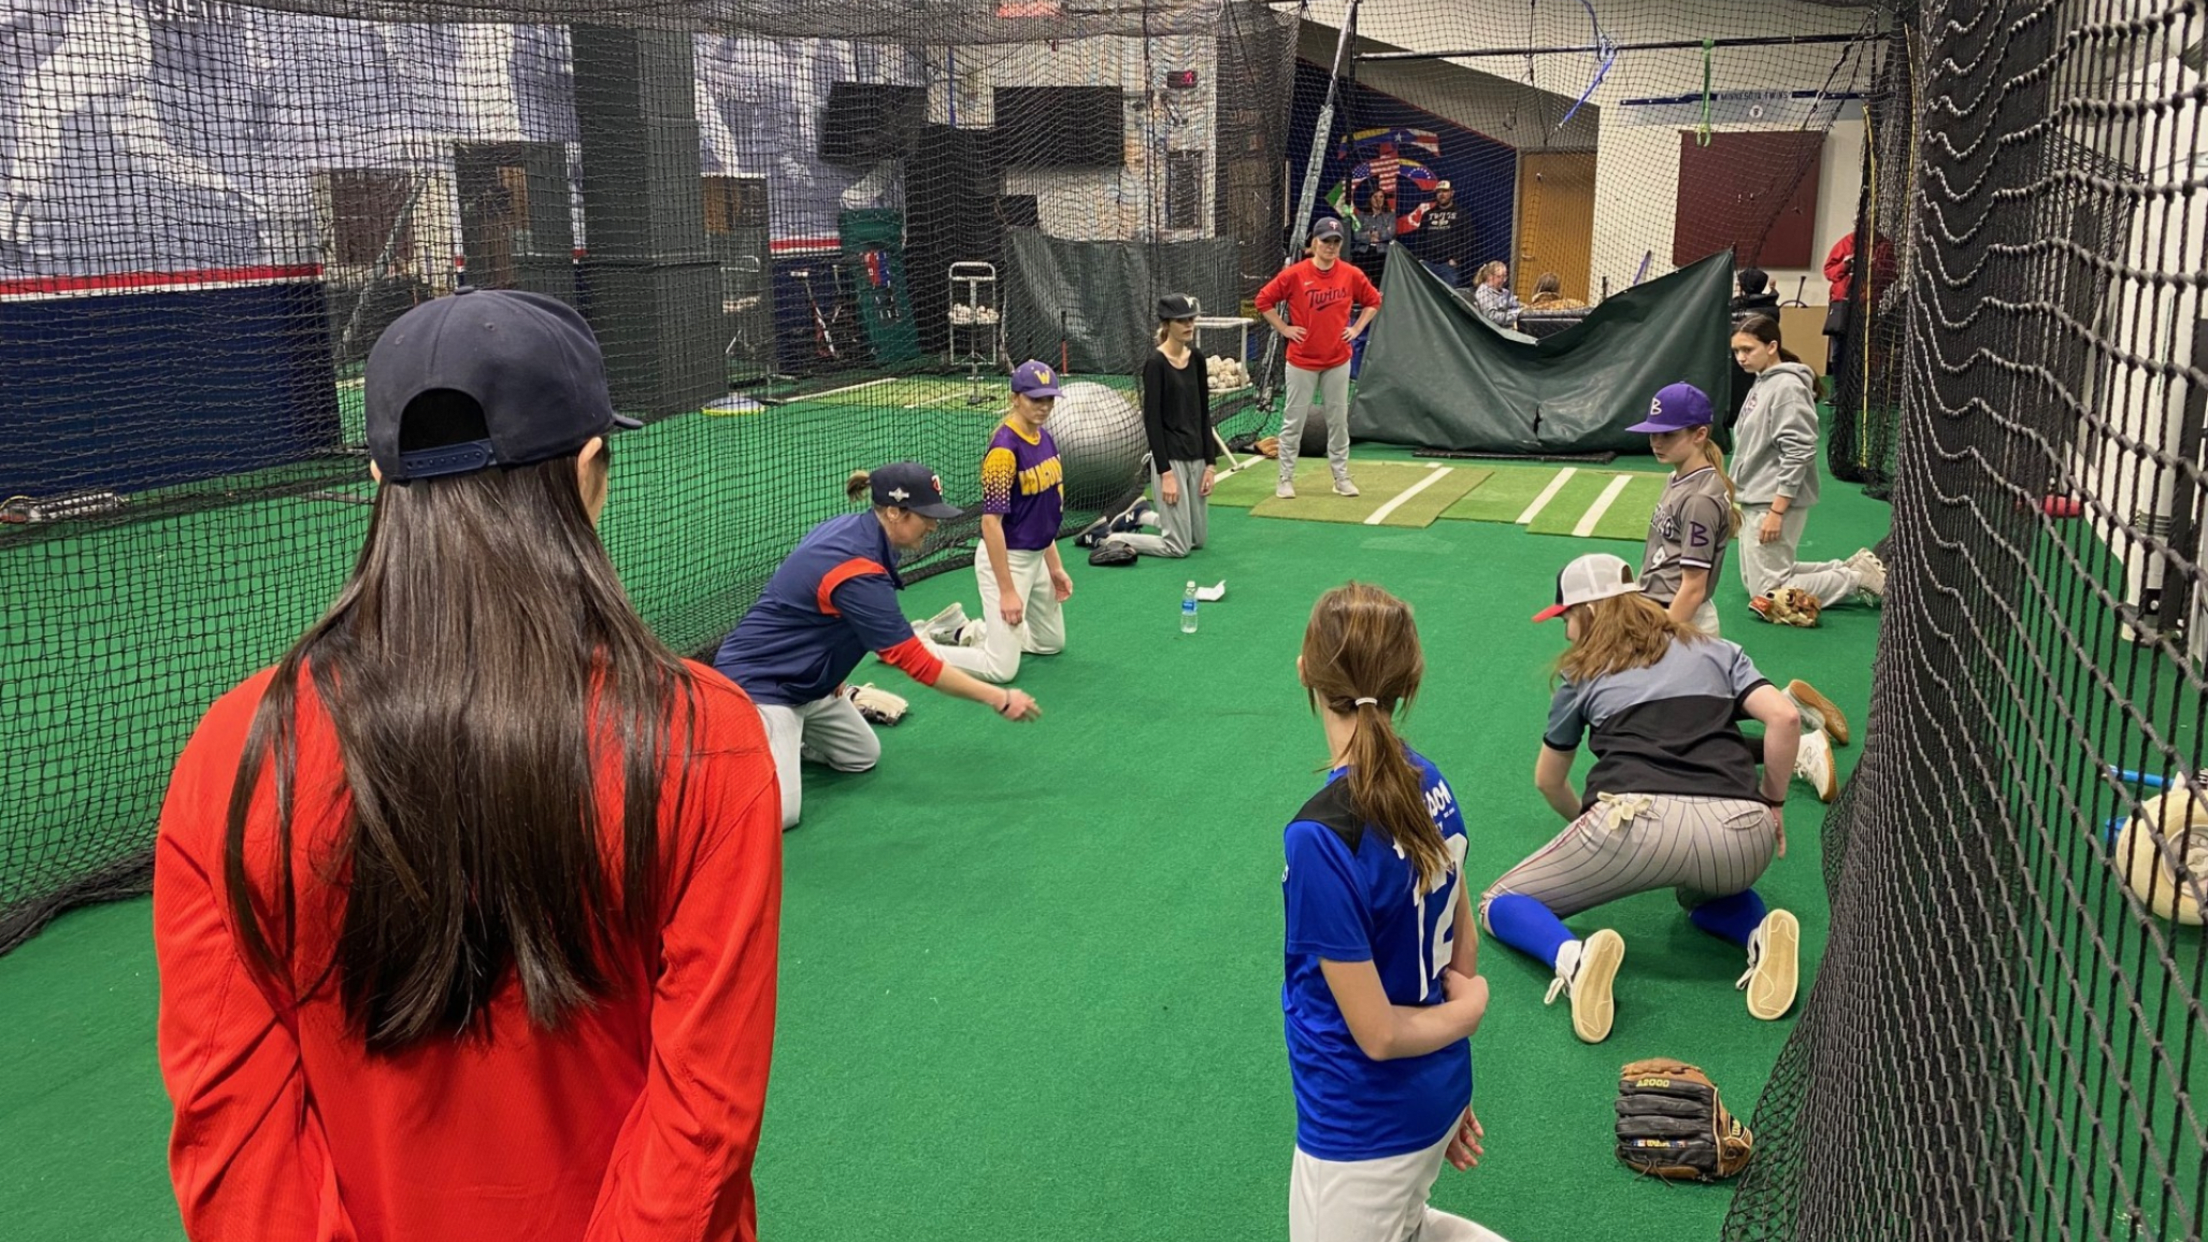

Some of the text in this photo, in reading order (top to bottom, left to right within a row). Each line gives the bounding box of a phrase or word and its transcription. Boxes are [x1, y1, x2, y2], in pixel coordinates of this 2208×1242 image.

[1305, 286, 1348, 309] Twins
[1034, 370, 1050, 385] W
[1650, 397, 1662, 416] B
[1125, 511, 1135, 523] N
[1085, 534, 1093, 544] N
[1689, 521, 1709, 547] B
[1636, 1078, 1670, 1088] A2000
